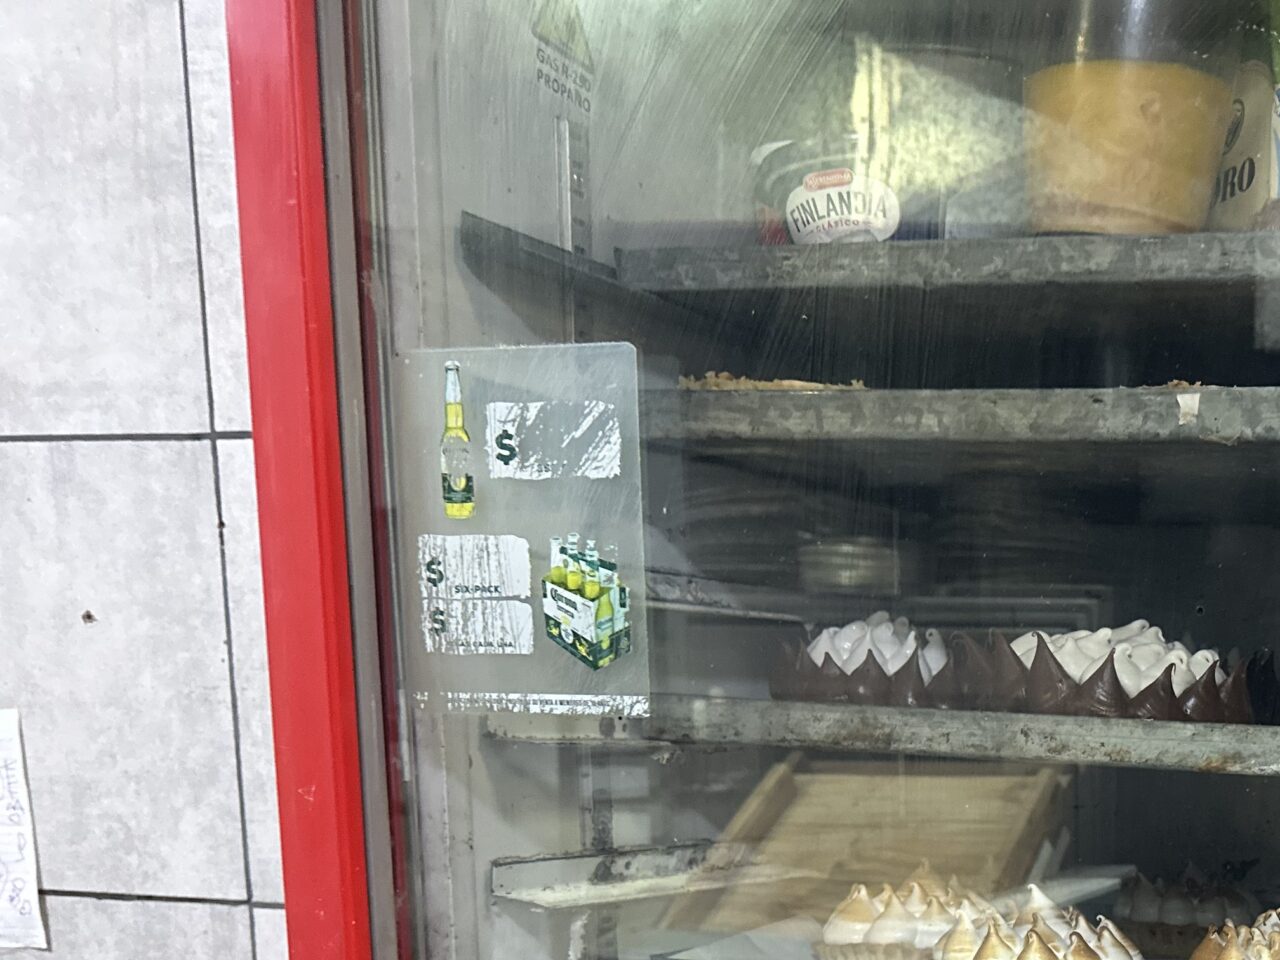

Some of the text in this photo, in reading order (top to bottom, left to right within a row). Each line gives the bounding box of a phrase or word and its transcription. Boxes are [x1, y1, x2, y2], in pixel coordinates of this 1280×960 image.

[536, 47, 560, 73] GAS
[789, 190, 888, 234] FINLANDIA
[495, 429, 518, 466] $
[425, 556, 446, 588] $
[454, 584, 502, 594] SIX-PACK
